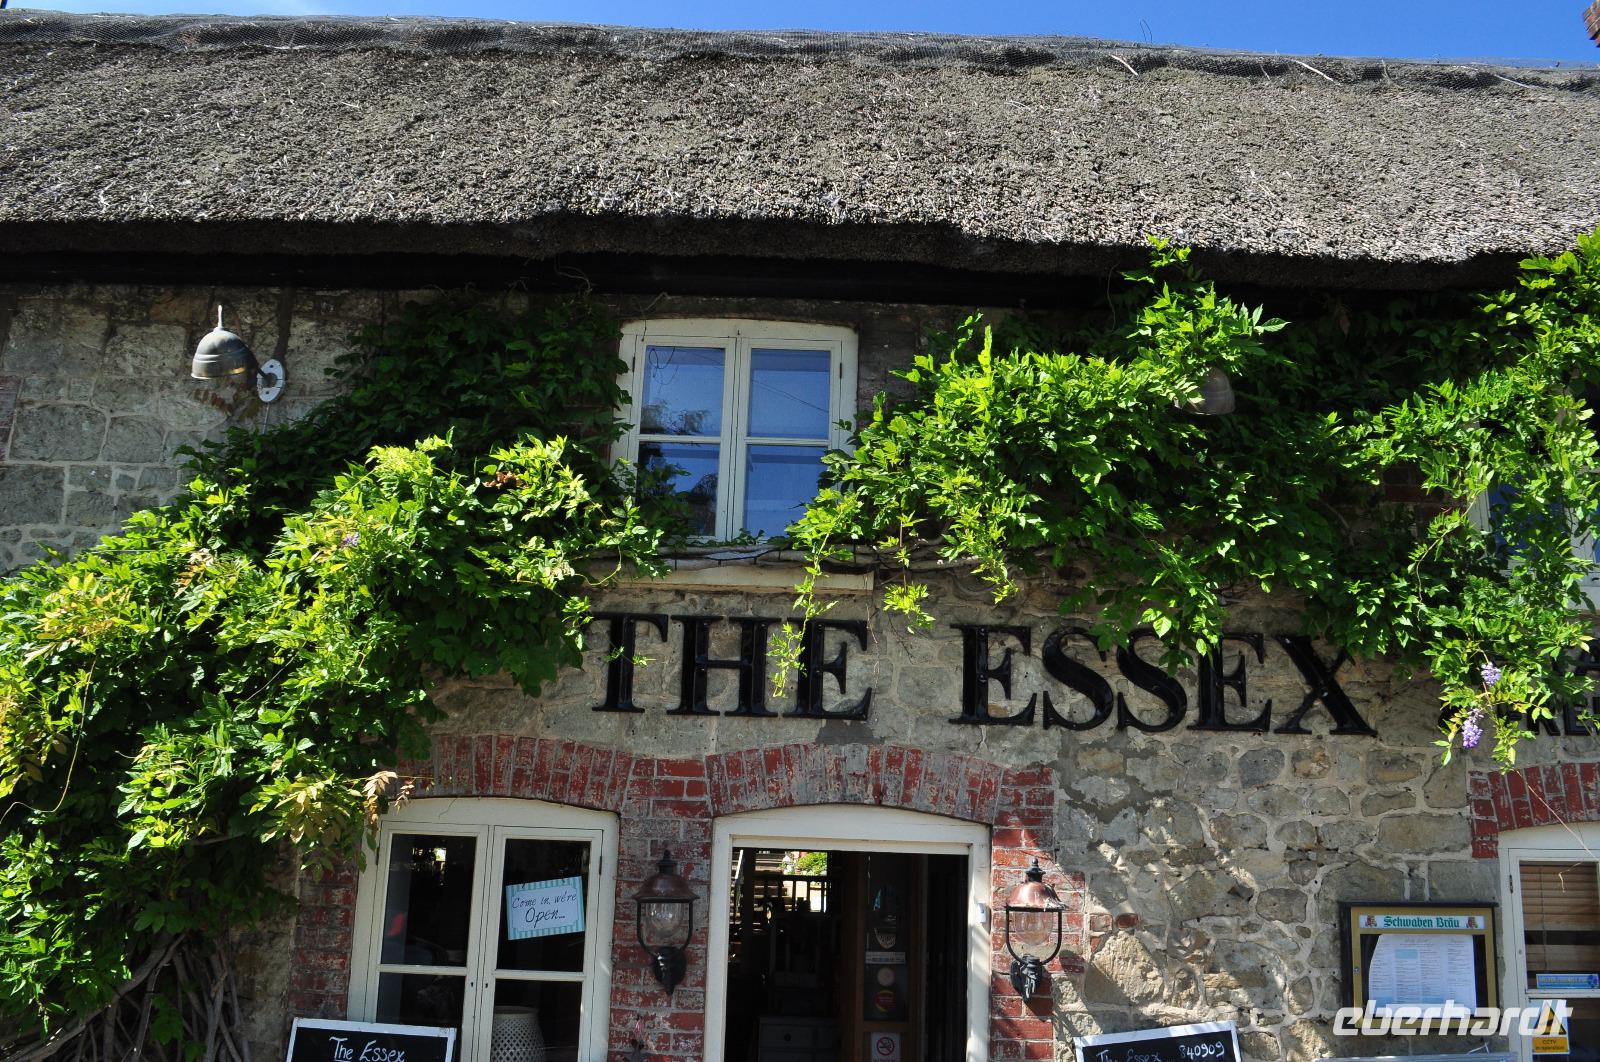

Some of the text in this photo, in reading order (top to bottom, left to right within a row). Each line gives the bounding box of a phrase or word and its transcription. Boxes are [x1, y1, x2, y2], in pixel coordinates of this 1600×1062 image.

[586, 611, 1378, 738] THE ESSEX
[512, 896, 537, 909] Come
[1383, 915, 1460, 928] Schwaben Bräu
[329, 1036, 405, 1062] The Essex
[1095, 1049, 1119, 1062] Th
